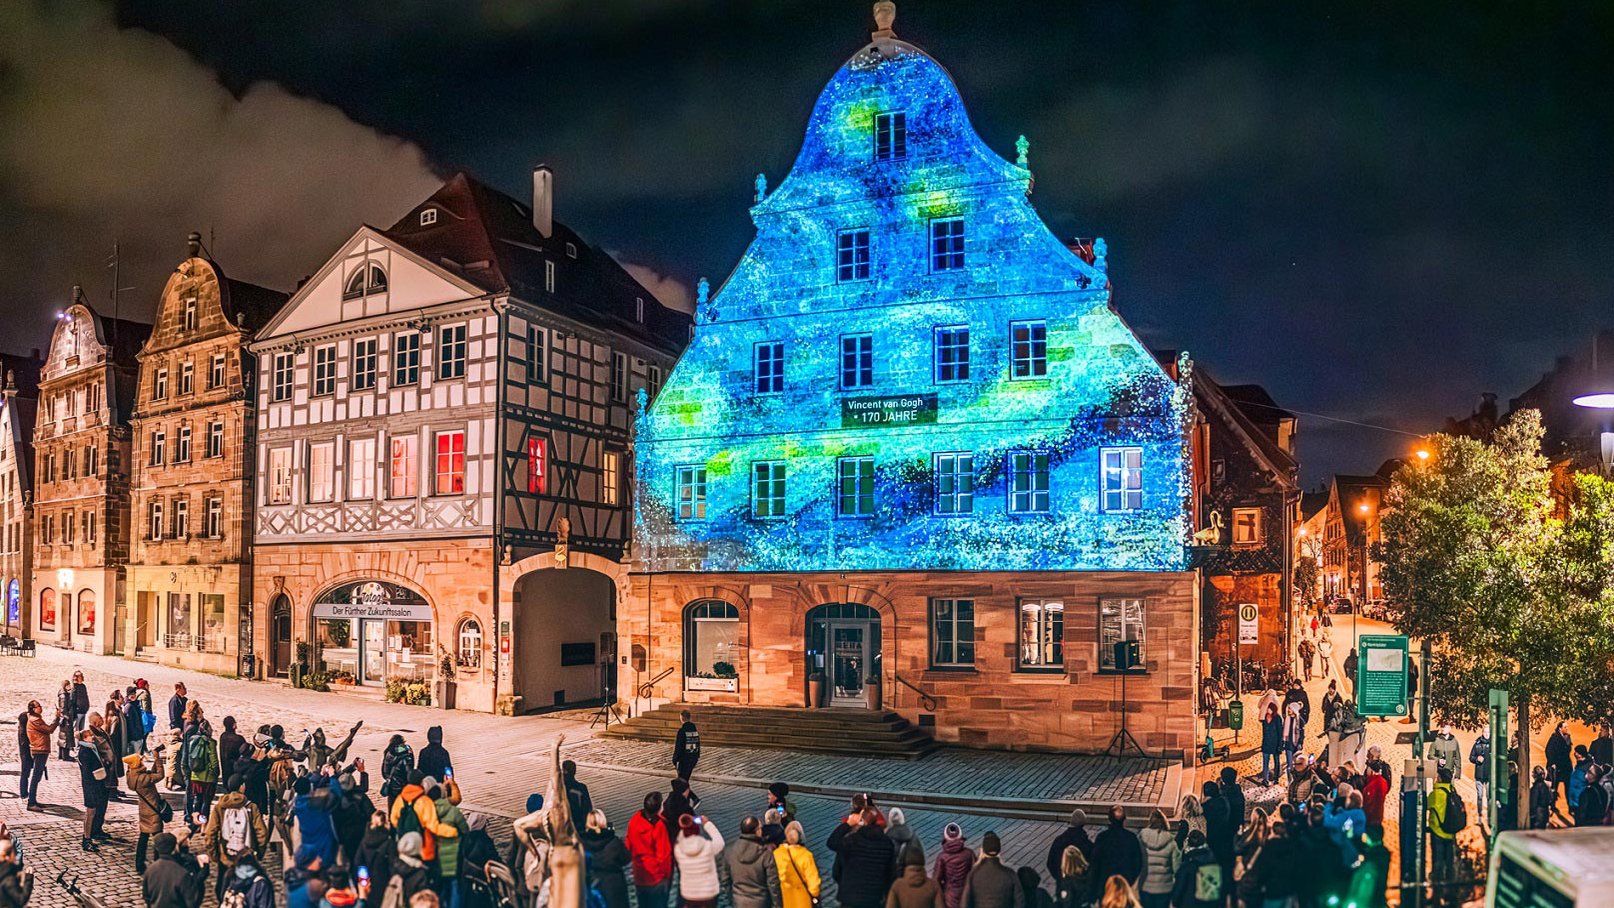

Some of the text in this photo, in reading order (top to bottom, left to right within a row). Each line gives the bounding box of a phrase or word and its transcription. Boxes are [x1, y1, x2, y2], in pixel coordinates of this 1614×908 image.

[848, 397, 923, 410] Vincent van Gogh
[862, 409, 918, 422] 170 JAHRE
[332, 606, 412, 617] Der Fürther Zukunftssalon
